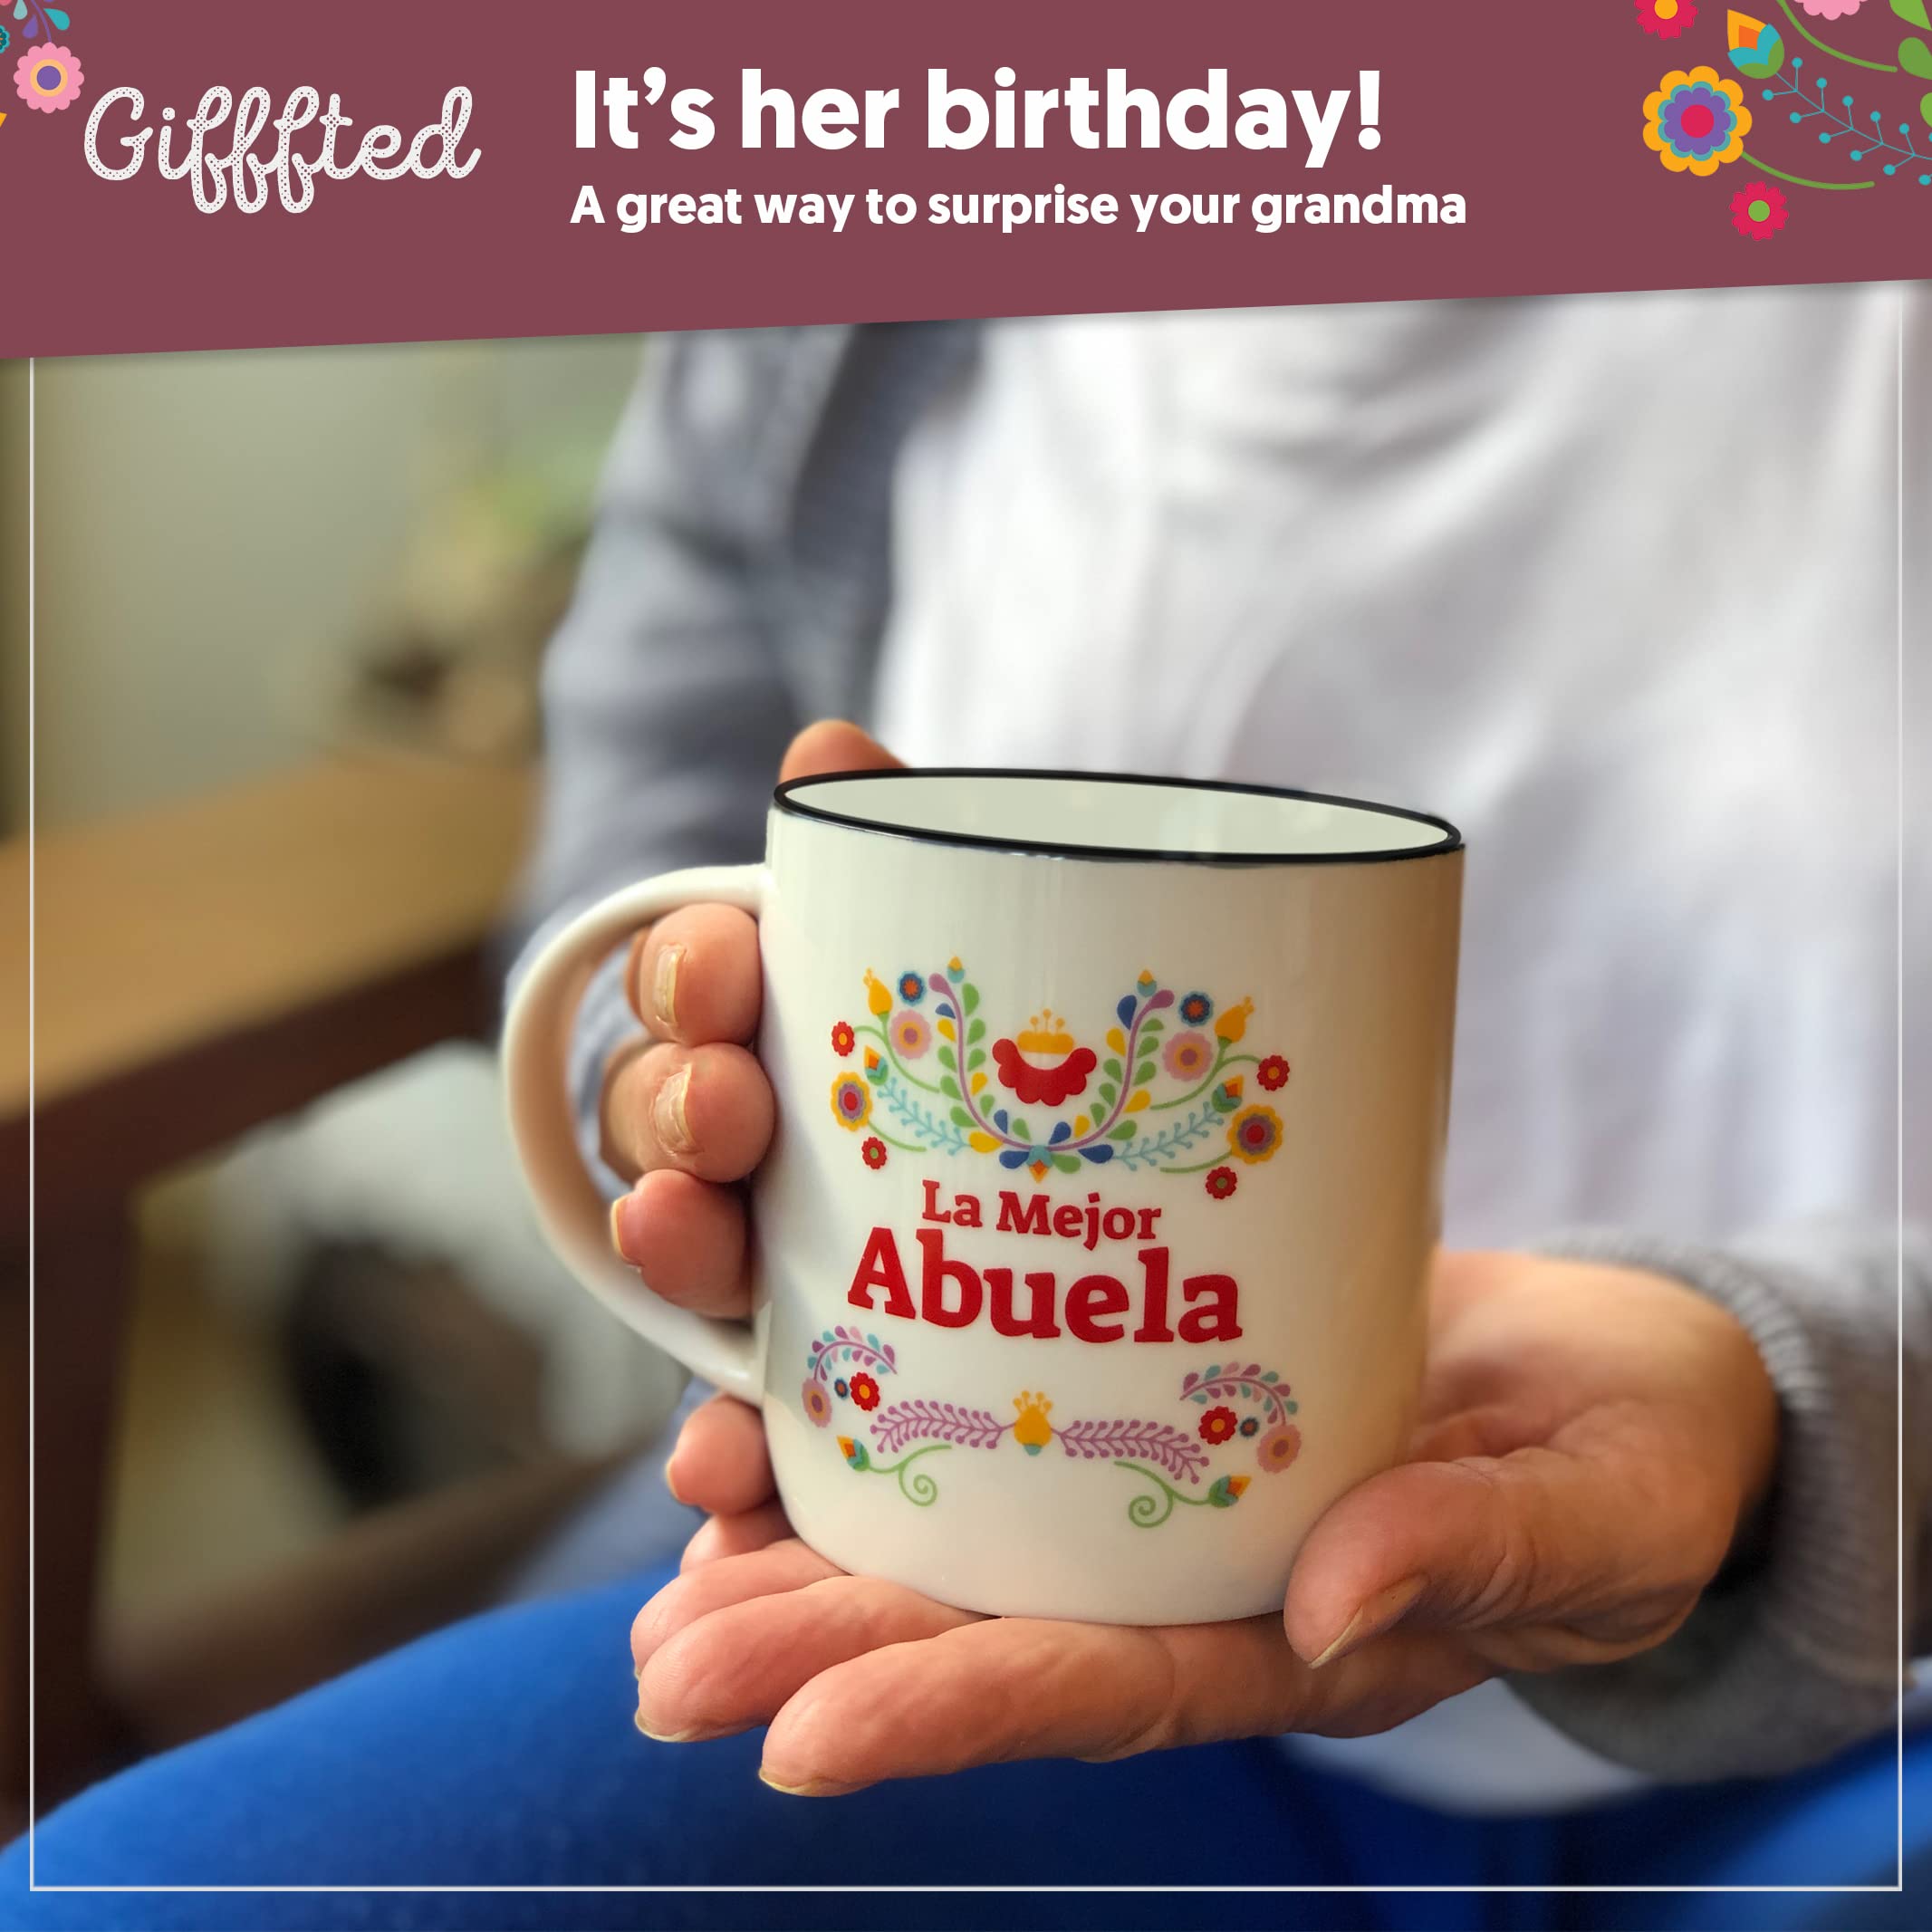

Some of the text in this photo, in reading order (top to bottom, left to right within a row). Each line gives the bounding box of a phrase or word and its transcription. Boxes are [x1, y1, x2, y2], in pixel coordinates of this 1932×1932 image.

[922, 1179, 1162, 1252] La Mejor
[847, 1226, 1244, 1344] Abuela
